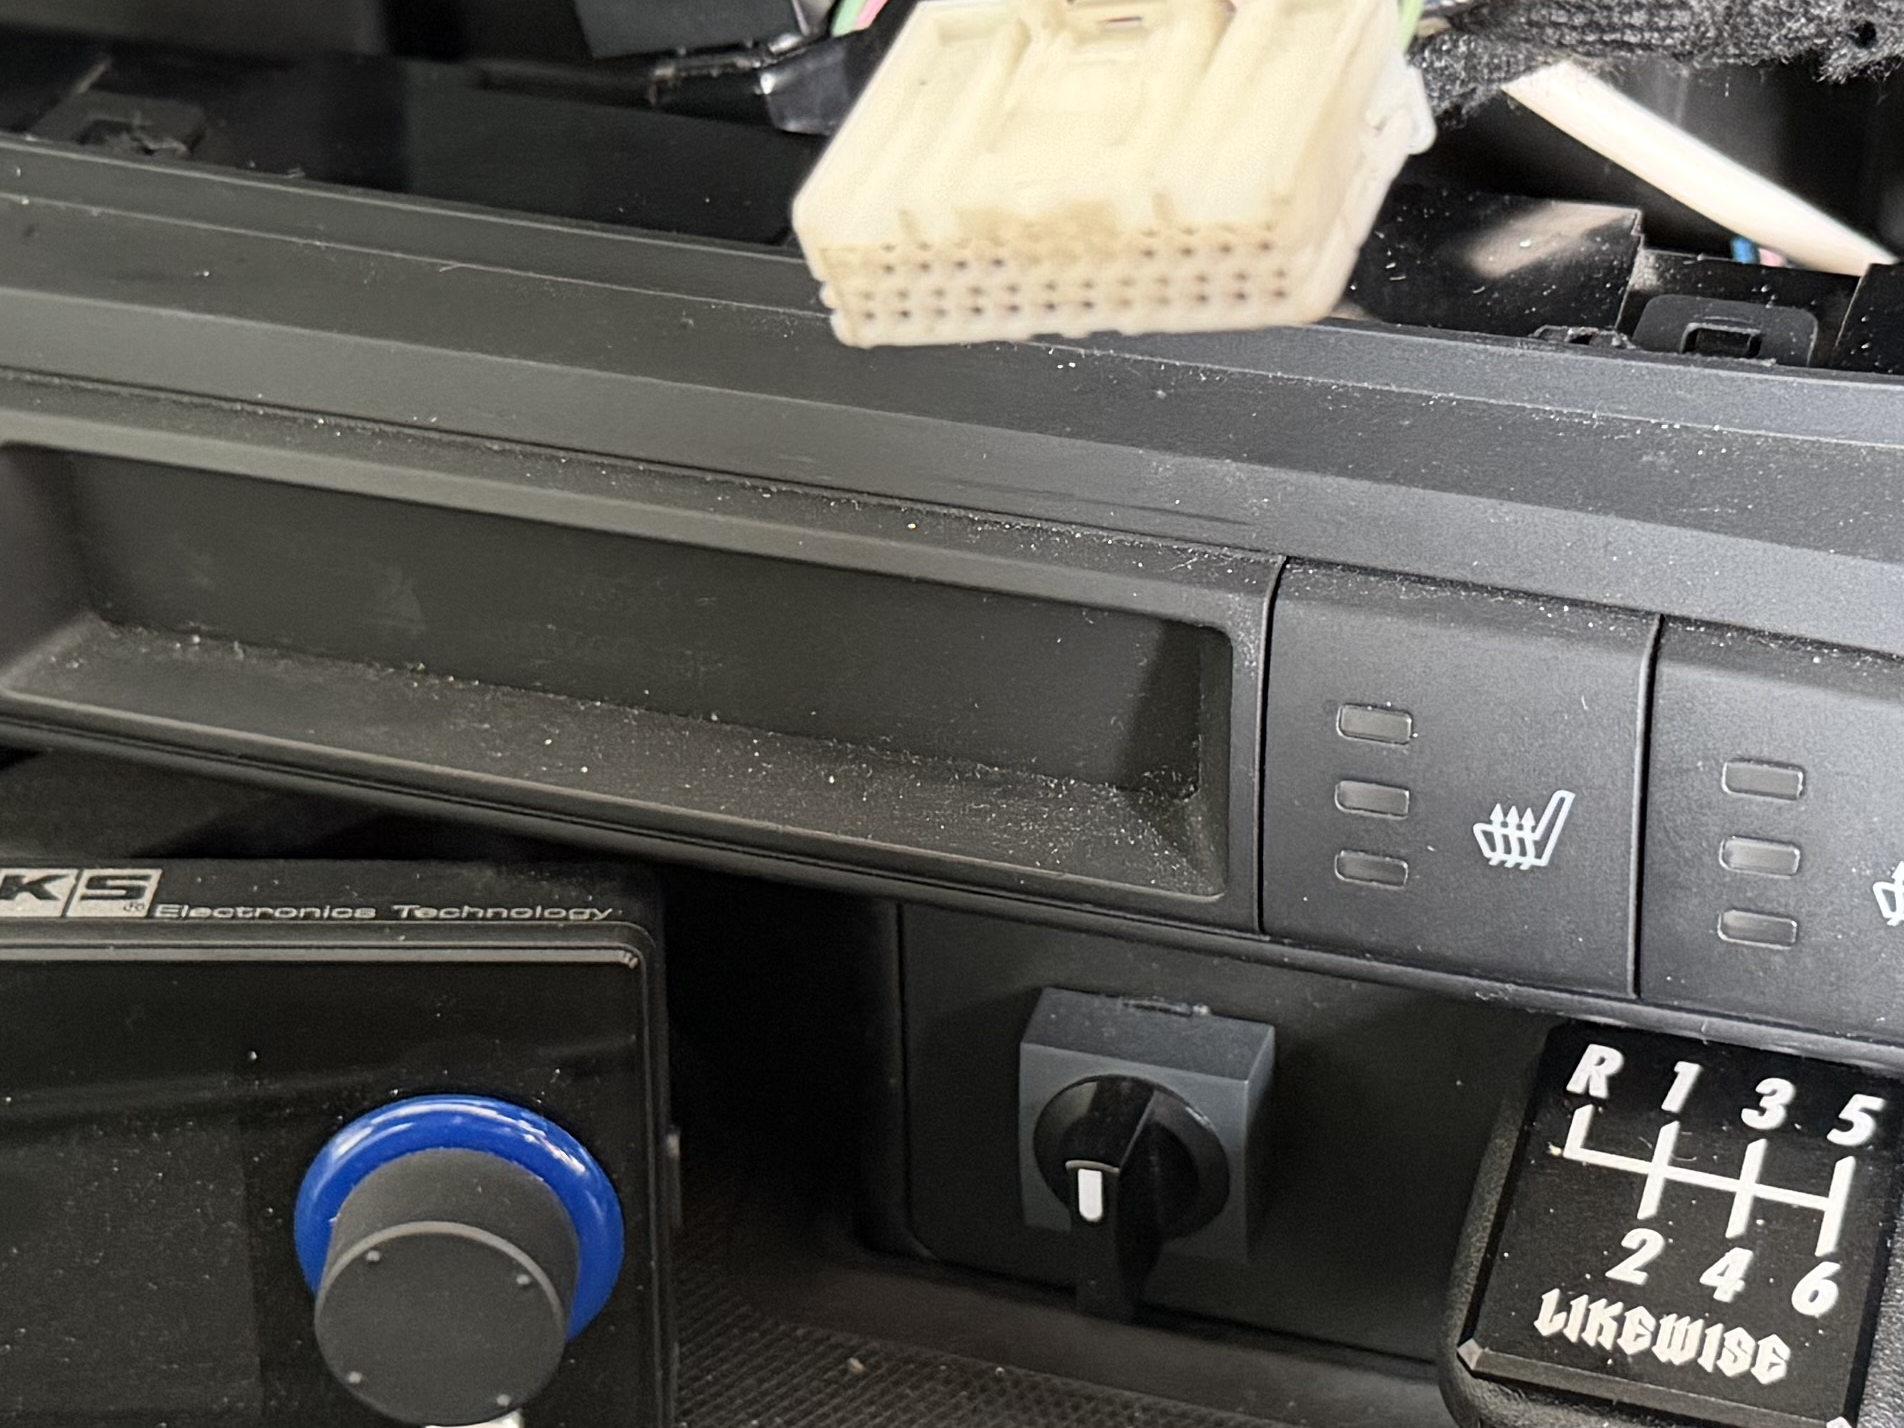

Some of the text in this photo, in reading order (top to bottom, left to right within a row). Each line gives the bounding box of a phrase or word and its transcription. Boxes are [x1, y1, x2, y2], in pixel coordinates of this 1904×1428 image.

[154, 902, 614, 924] Electronics Technology
[1565, 1043, 1886, 1147] R 1 3 5
[1605, 1227, 1841, 1317] 2 4 6
[1533, 1287, 1792, 1386] LIKEWISE
